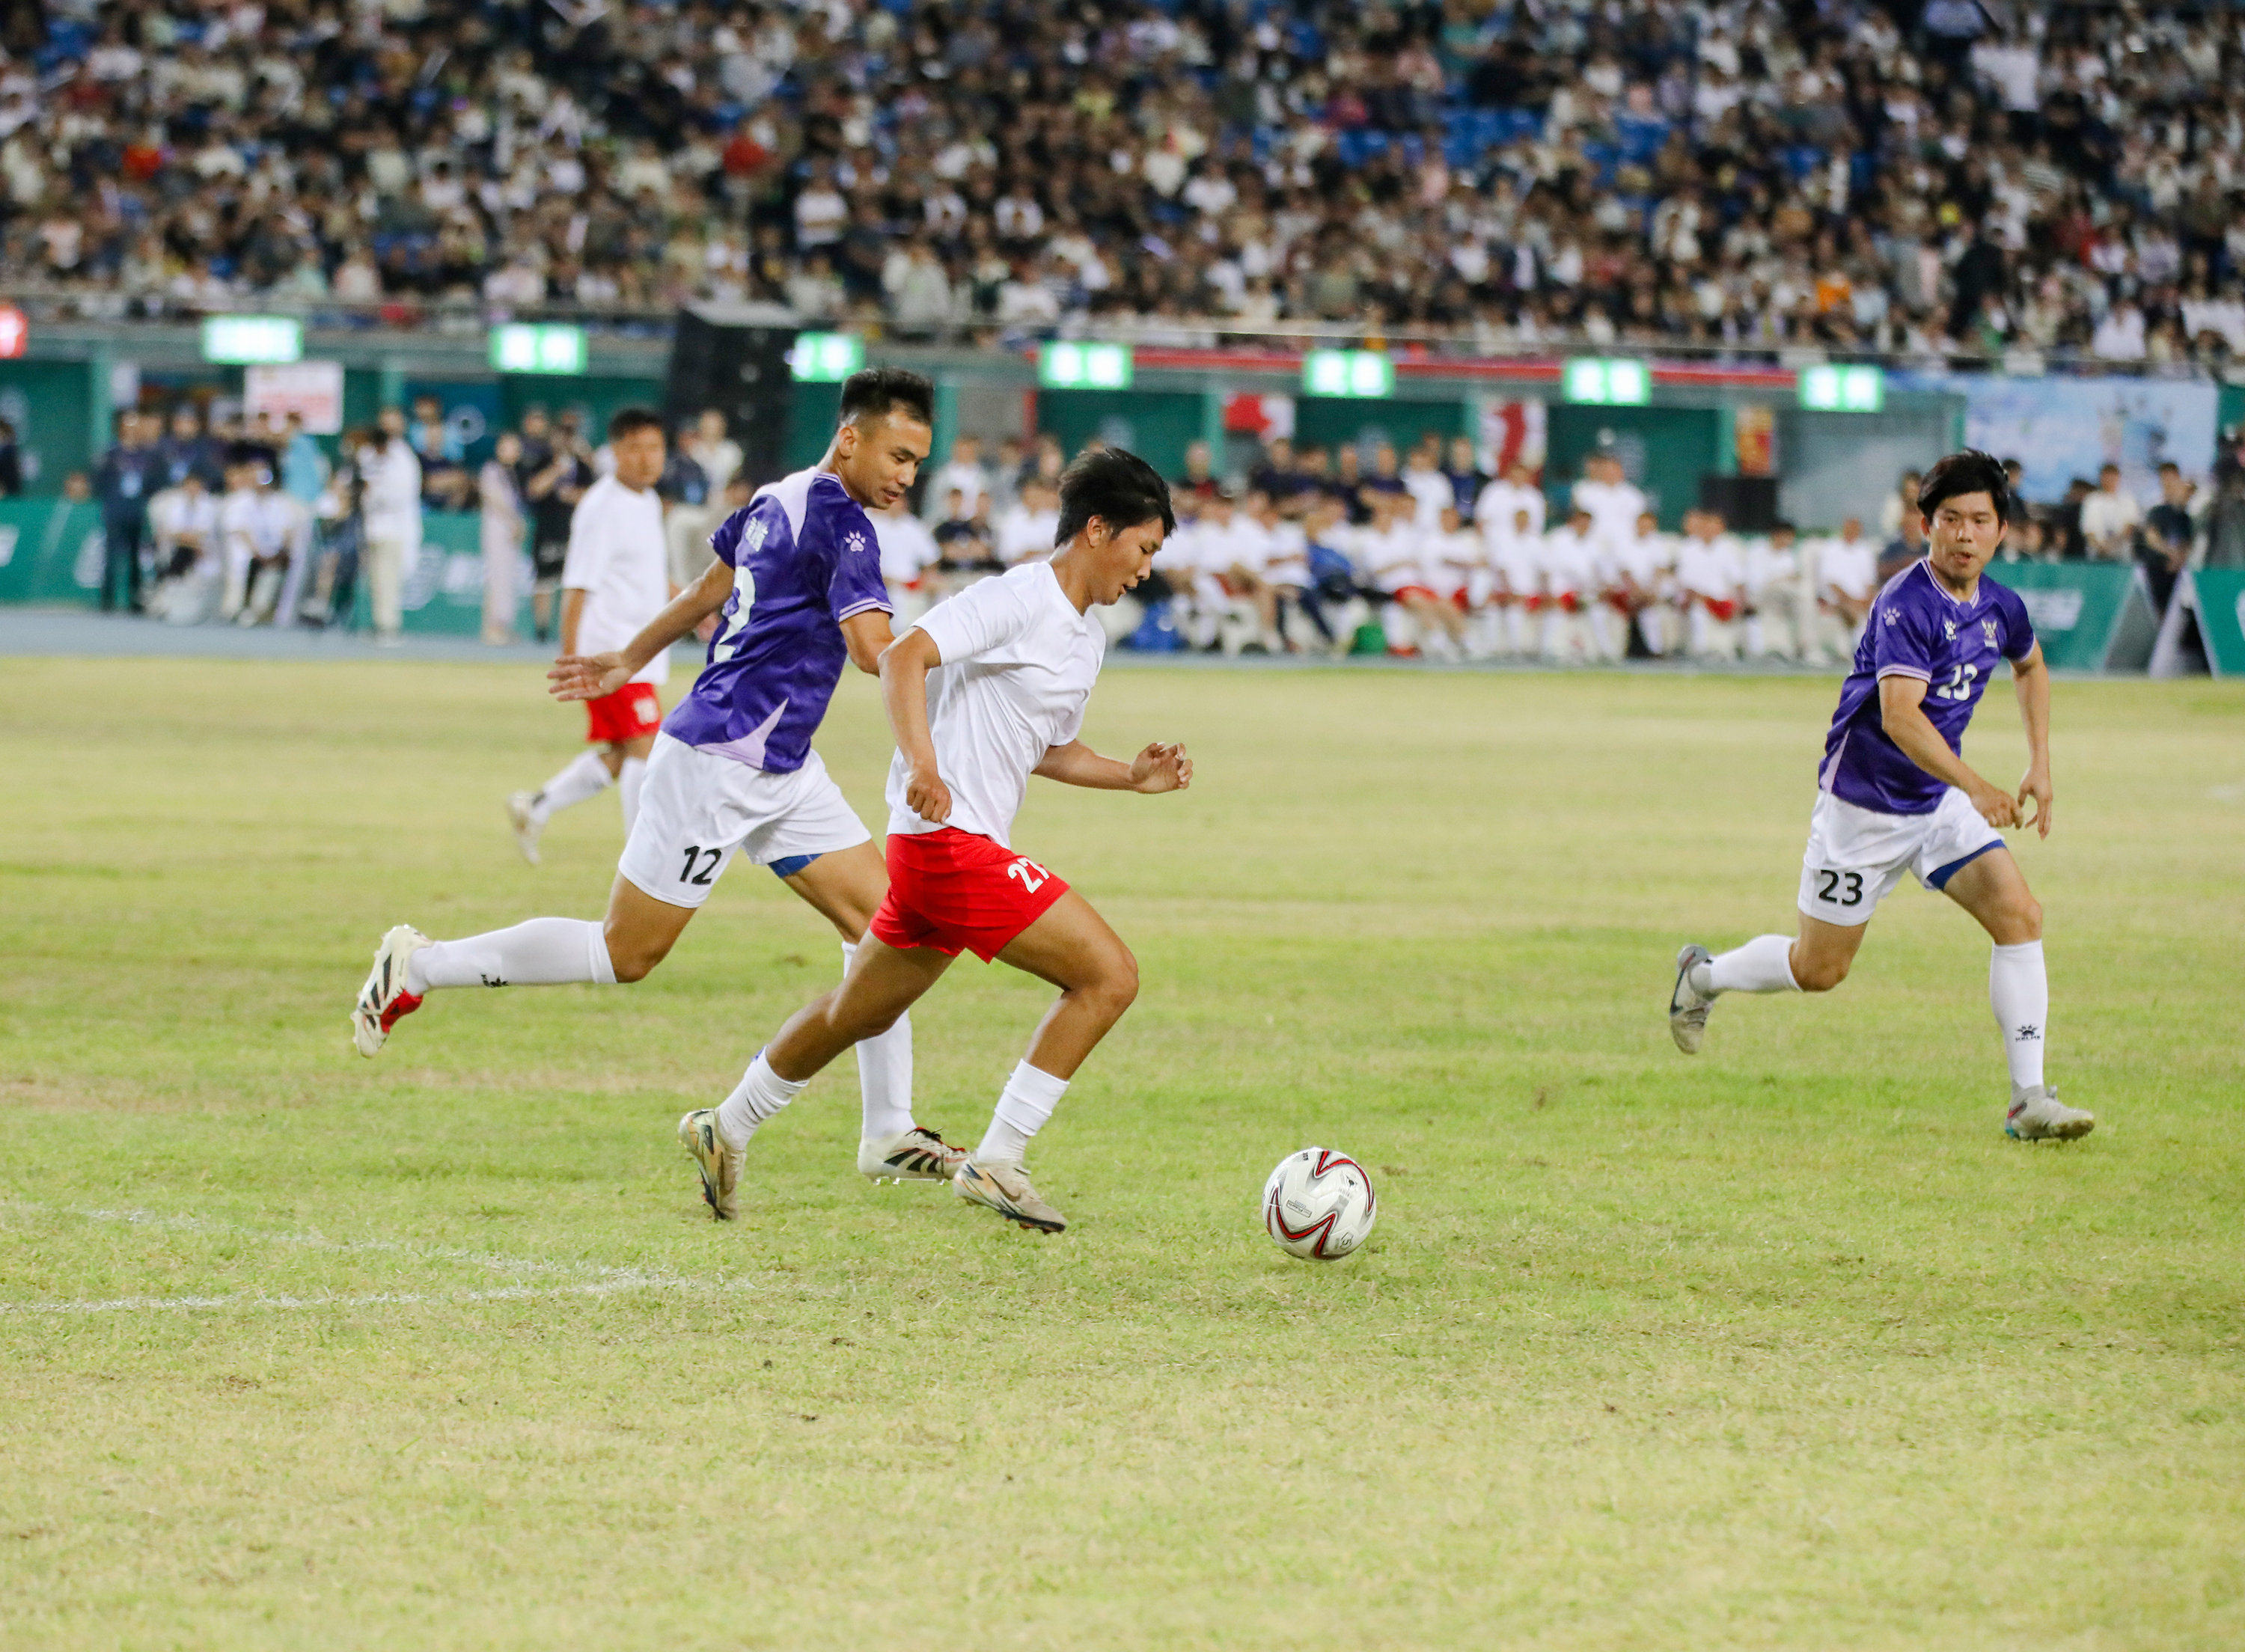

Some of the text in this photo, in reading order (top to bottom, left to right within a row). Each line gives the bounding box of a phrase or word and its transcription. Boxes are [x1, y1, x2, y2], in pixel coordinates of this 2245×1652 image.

[1936, 664, 1978, 701] 23
[679, 845, 721, 884] 12
[1007, 857, 1050, 894] 27
[1818, 869, 1863, 906] 23
